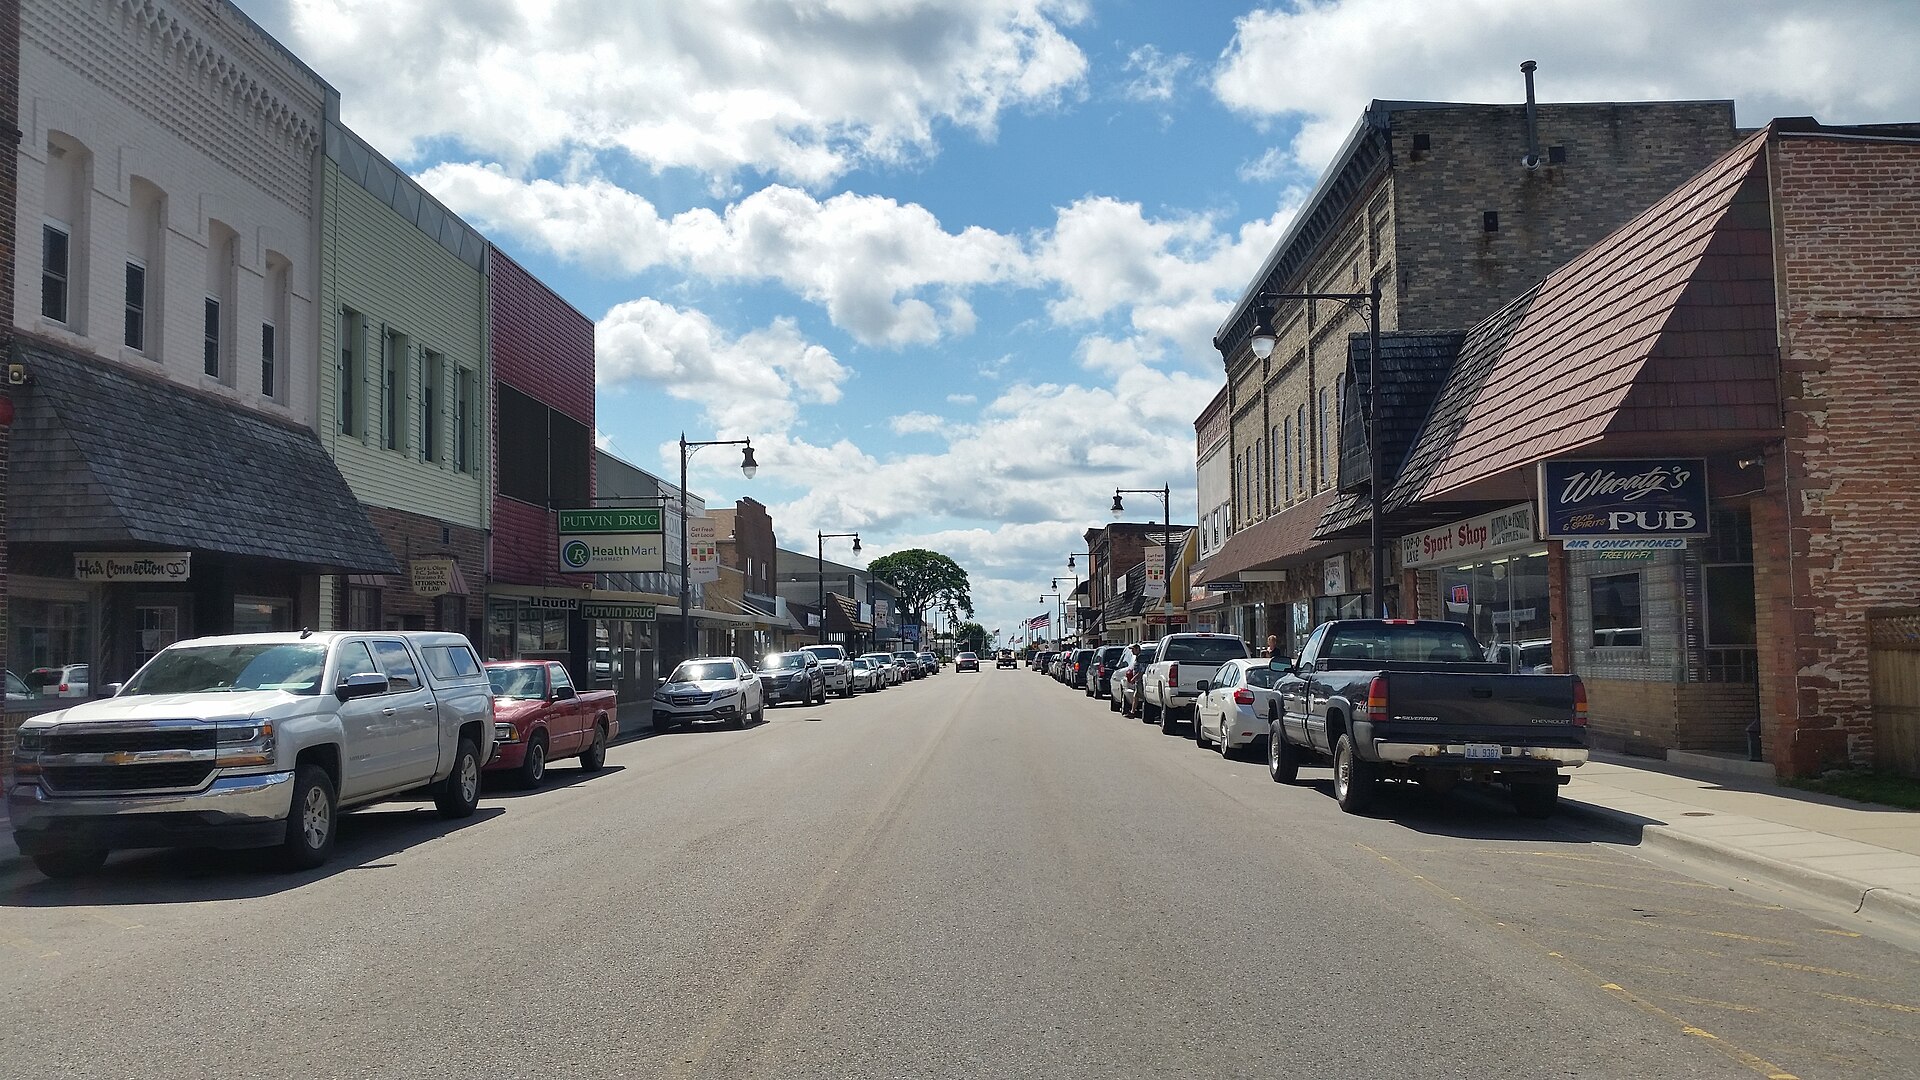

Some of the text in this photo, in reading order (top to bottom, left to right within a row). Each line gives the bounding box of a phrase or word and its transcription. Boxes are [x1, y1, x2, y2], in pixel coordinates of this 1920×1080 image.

[1561, 466, 1691, 504] Wheaty's
[563, 514, 657, 527] PUTVIN DRUG
[1563, 518, 1606, 531] & SPIRITS
[1570, 514, 1594, 523] FOOD
[1608, 511, 1697, 531] PUB
[1423, 523, 1487, 560] Sport Shop
[1566, 538, 1683, 549] AIR CONDITIONED
[592, 546, 629, 556] Health
[631, 546, 657, 556] Mart
[1406, 550, 1419, 563] LAKE
[1600, 551, 1625, 560] FREE
[78, 559, 165, 579] Hair Connection
[530, 596, 577, 608] LIQUOR
[625, 607, 654, 619] DRUG
